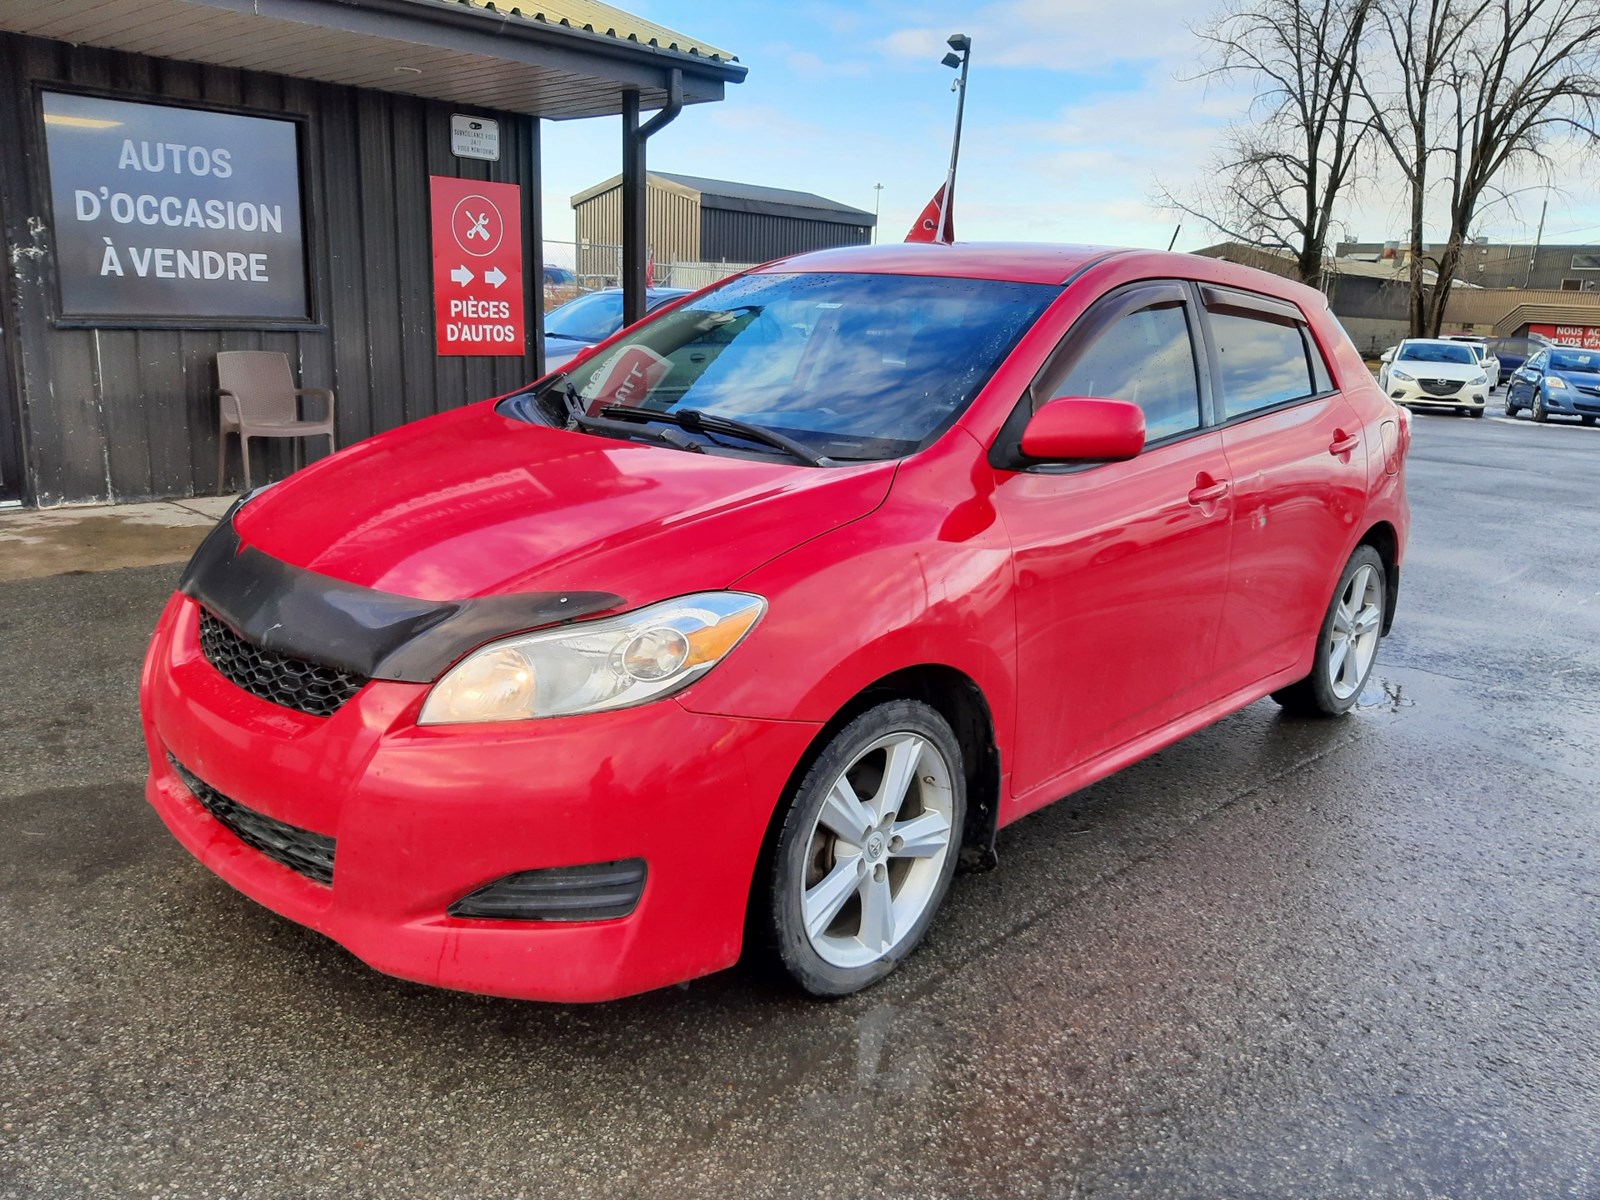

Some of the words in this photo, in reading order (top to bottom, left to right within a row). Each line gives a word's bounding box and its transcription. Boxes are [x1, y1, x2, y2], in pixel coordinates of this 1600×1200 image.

[118, 139, 232, 178] AUTOS
[74, 186, 282, 233] D'OCCASION
[100, 237, 124, 277] À
[128, 247, 269, 282] VENDRE
[451, 295, 510, 319] PIÈCES
[446, 322, 515, 342] D'AUTOS
[1556, 327, 1583, 335] NOUS
[1562, 337, 1582, 346] VOS
